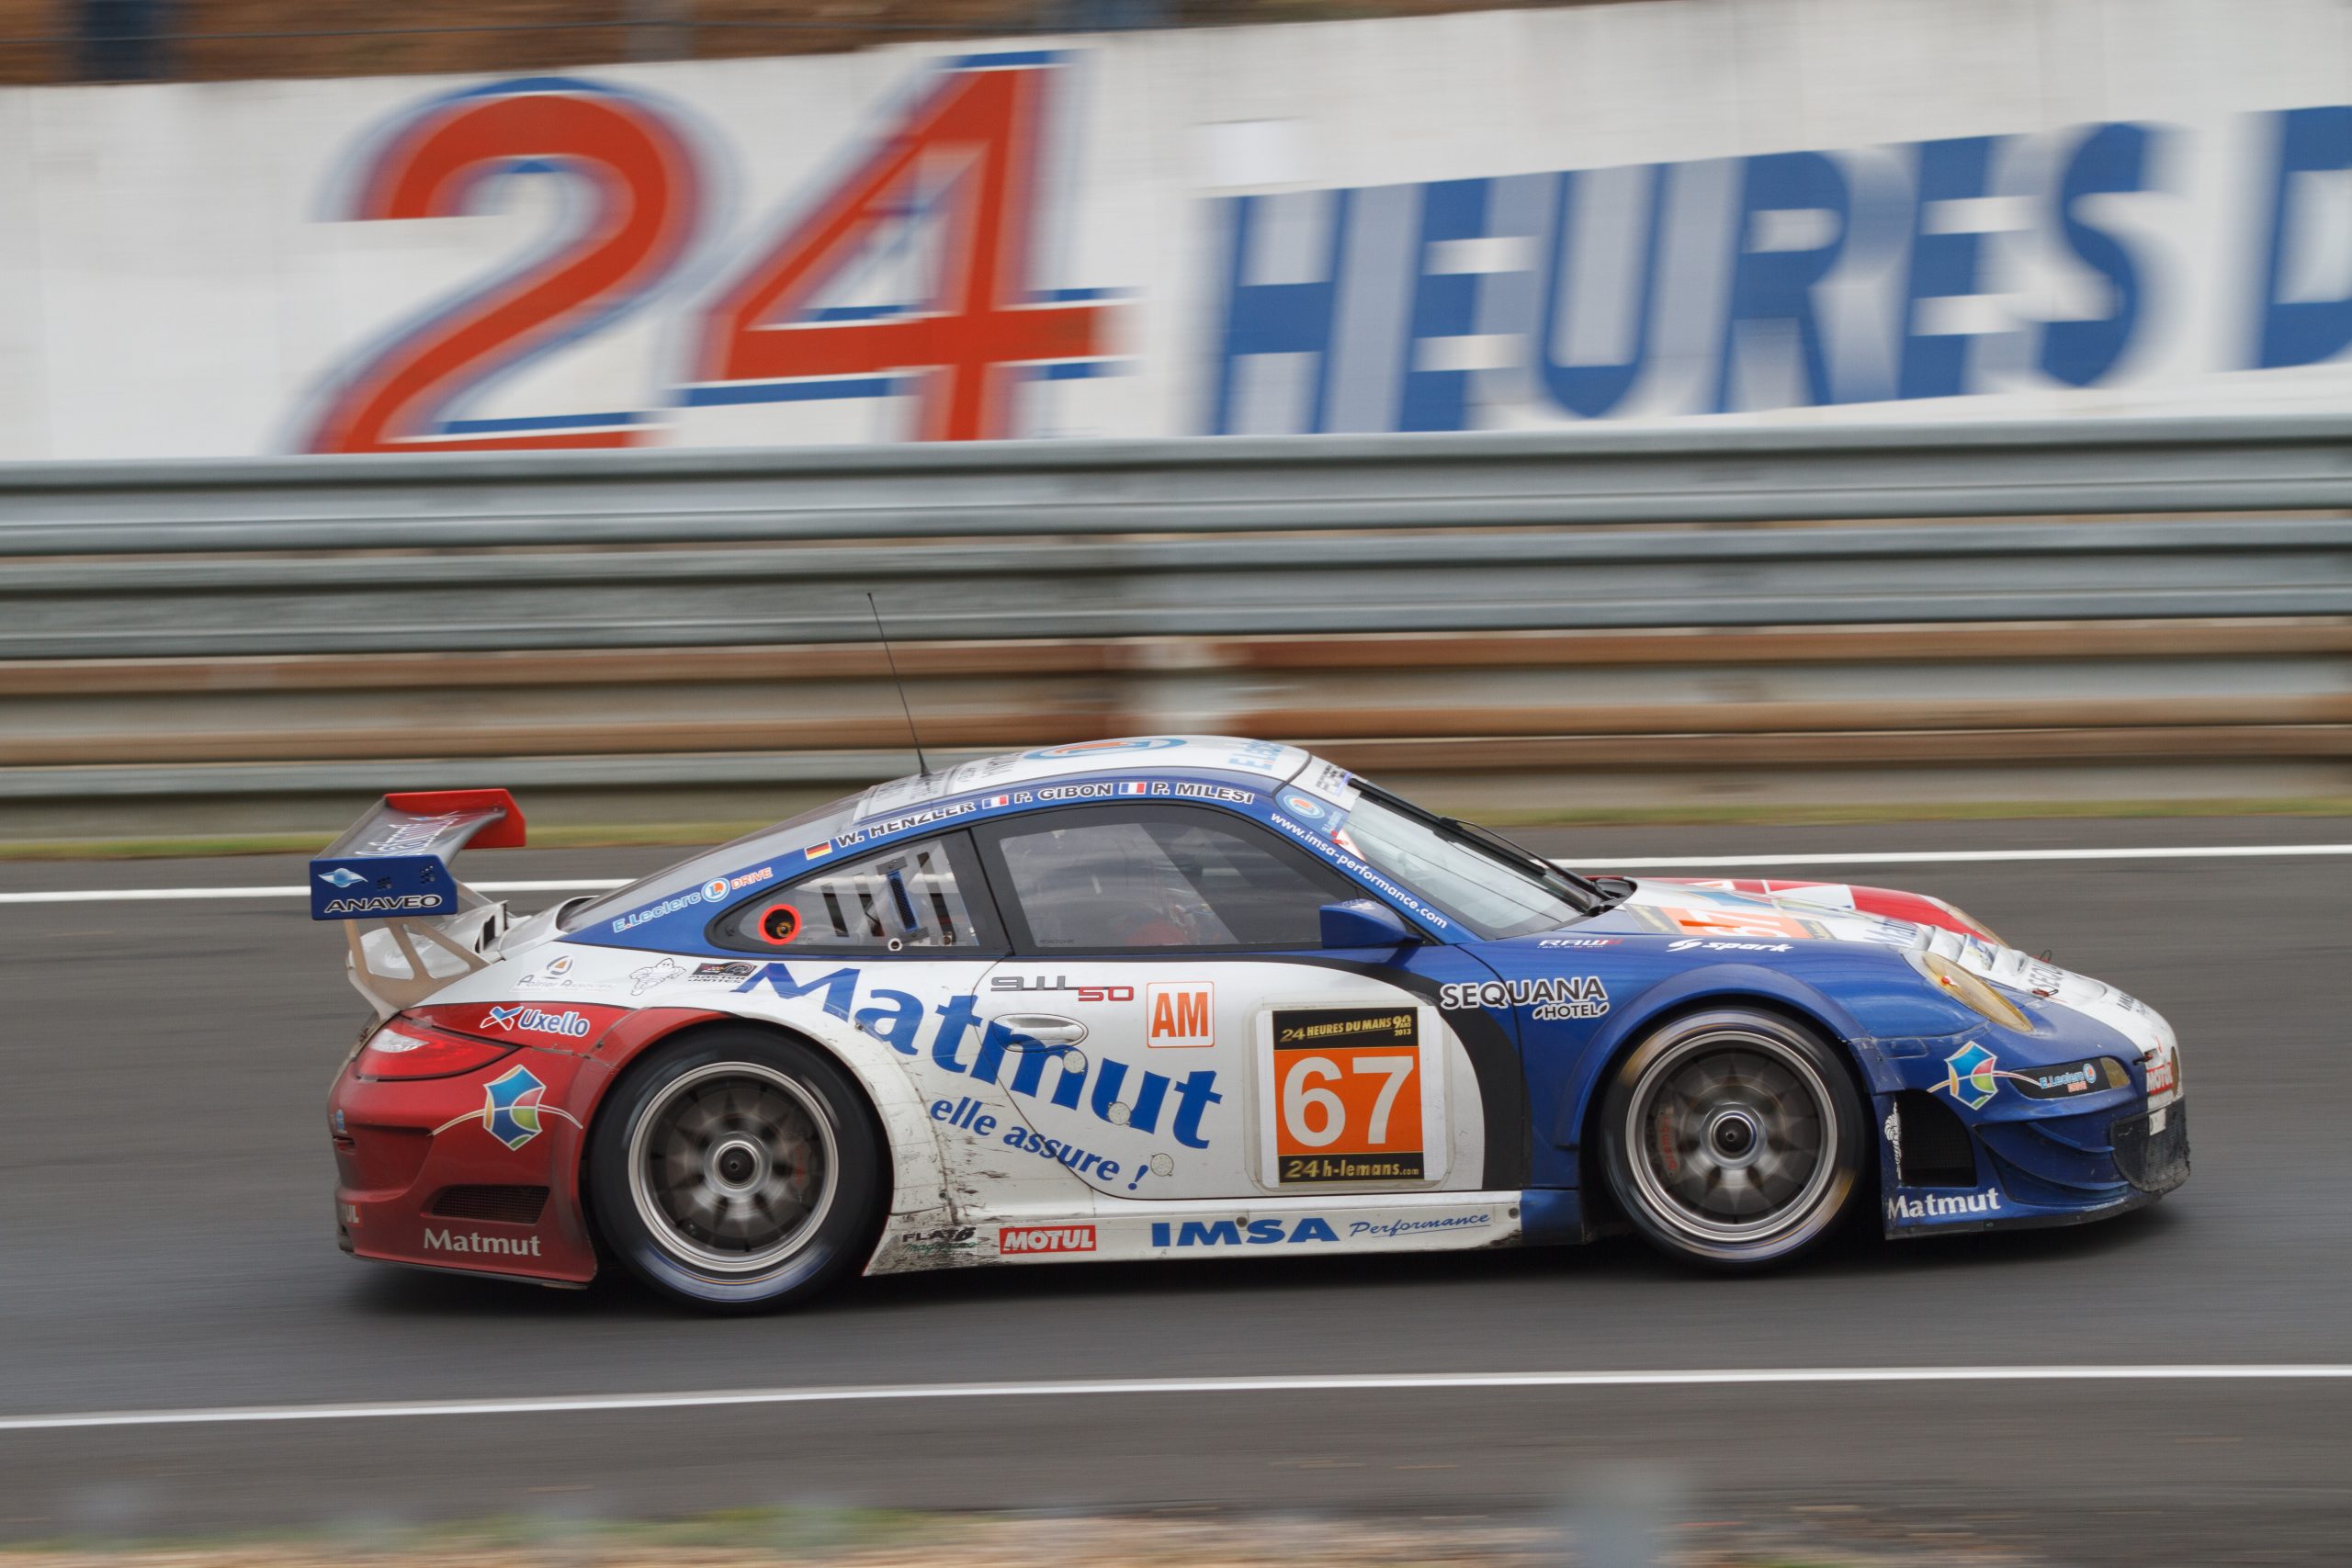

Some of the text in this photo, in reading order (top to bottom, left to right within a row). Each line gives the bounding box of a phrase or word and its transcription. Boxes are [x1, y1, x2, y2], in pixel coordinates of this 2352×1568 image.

[303, 46, 1144, 456] 24
[1199, 119, 2176, 437] HEURES
[1014, 784, 1114, 804] P. GIBON
[1151, 782, 1254, 805] P. MILESI
[836, 802, 976, 849] W. HENZLER
[731, 867, 773, 889] DRIVE
[1271, 812, 1448, 929] www.imsa-performance.com
[324, 895, 443, 913] ANAVEO
[1702, 942, 1793, 953] spark
[1078, 986, 1135, 1002] 50
[1440, 976, 1608, 1010] SEQUANA
[520, 1009, 589, 1036] Uxello
[1151, 992, 1209, 1038] AM
[1542, 1003, 1597, 1020] HOTEL
[1280, 1027, 1306, 1042] 24
[1306, 1023, 1344, 1037] HEURES
[1346, 1021, 1363, 1033] DU
[1363, 1018, 1392, 1030] MANS
[729, 963, 1223, 1149] Matmut
[1283, 1055, 1415, 1147] 67
[930, 1096, 997, 1136] elle
[1002, 1122, 1122, 1182] assure
[1888, 1188, 2001, 1219] Matmut
[423, 1228, 542, 1257] Matmut
[1003, 1228, 1093, 1252] MOTUL
[1151, 1213, 1492, 1247] IMSA Performance
